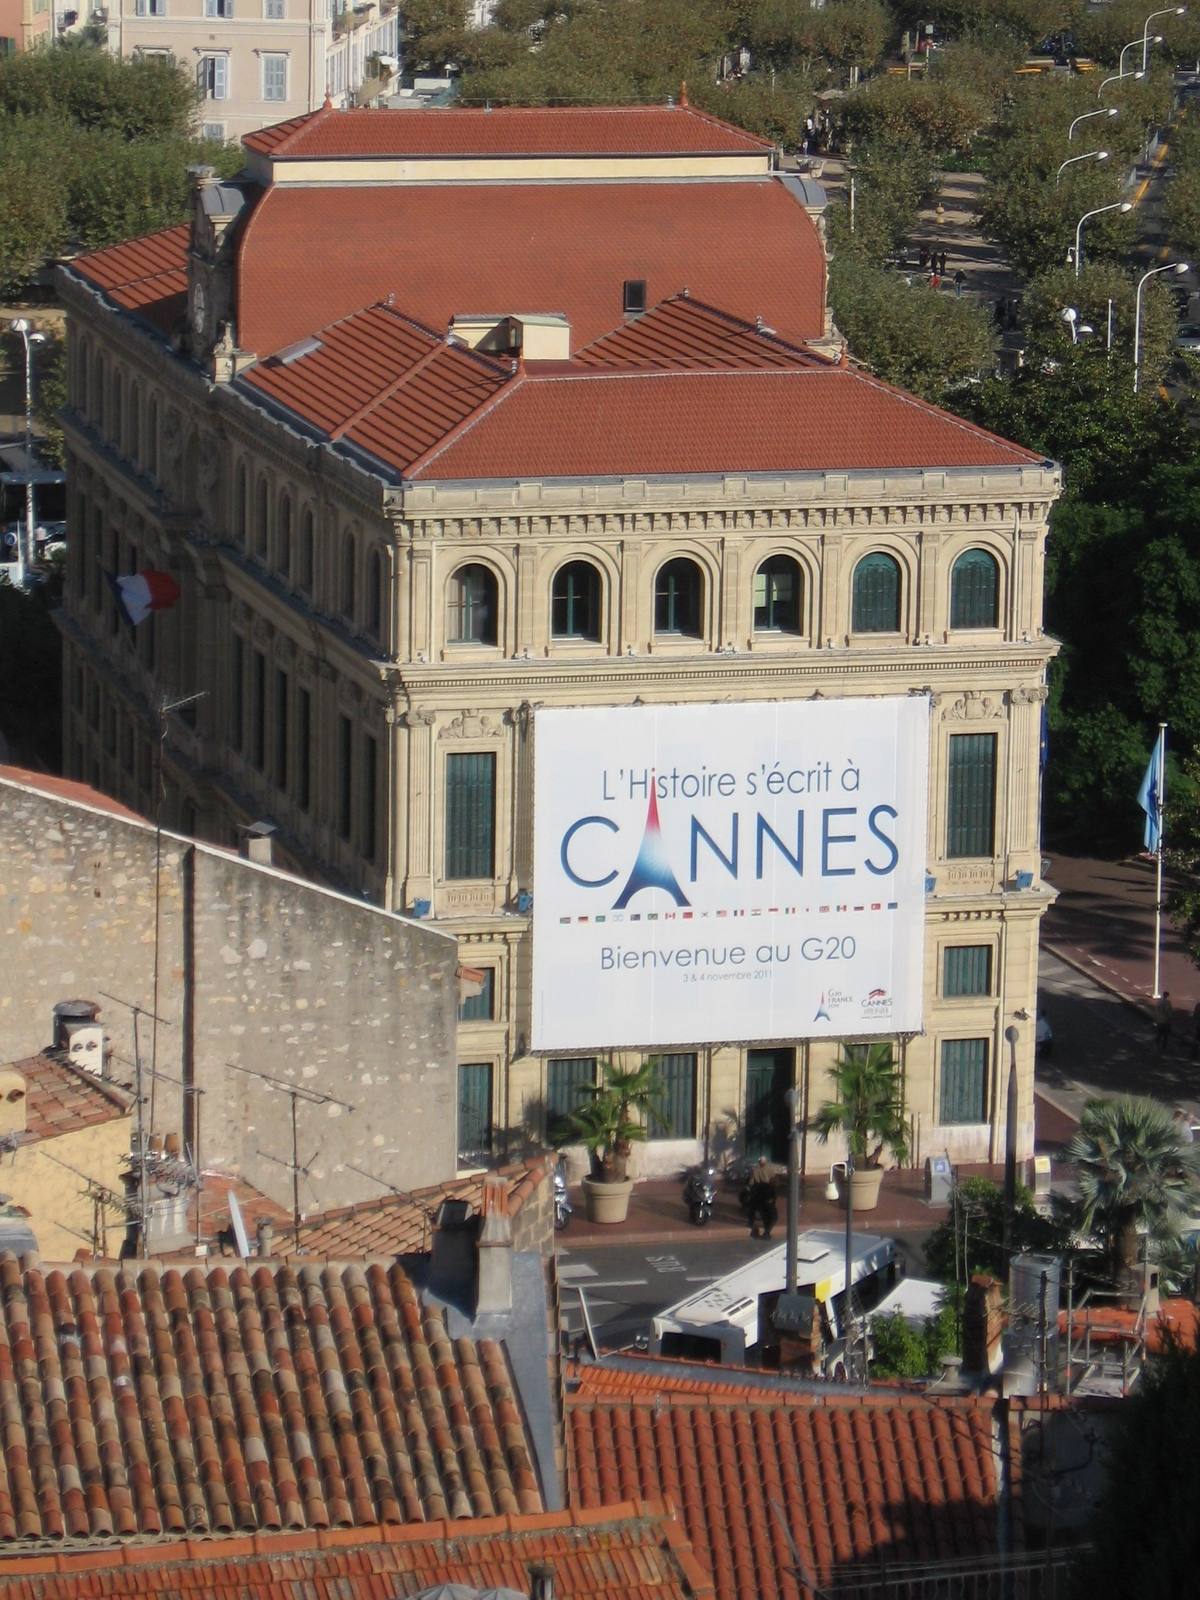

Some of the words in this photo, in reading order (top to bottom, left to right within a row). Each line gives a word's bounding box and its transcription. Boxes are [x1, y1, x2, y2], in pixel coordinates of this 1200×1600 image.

[602, 765, 736, 801] L'Histoire
[746, 761, 832, 796] s'écrit
[840, 758, 861, 792] à
[560, 804, 900, 910] CANNES
[600, 944, 746, 970] Bienvenue
[756, 945, 791, 963] au
[800, 936, 857, 961] G20
[682, 973, 689, 983] 3
[706, 971, 752, 981] novembre
